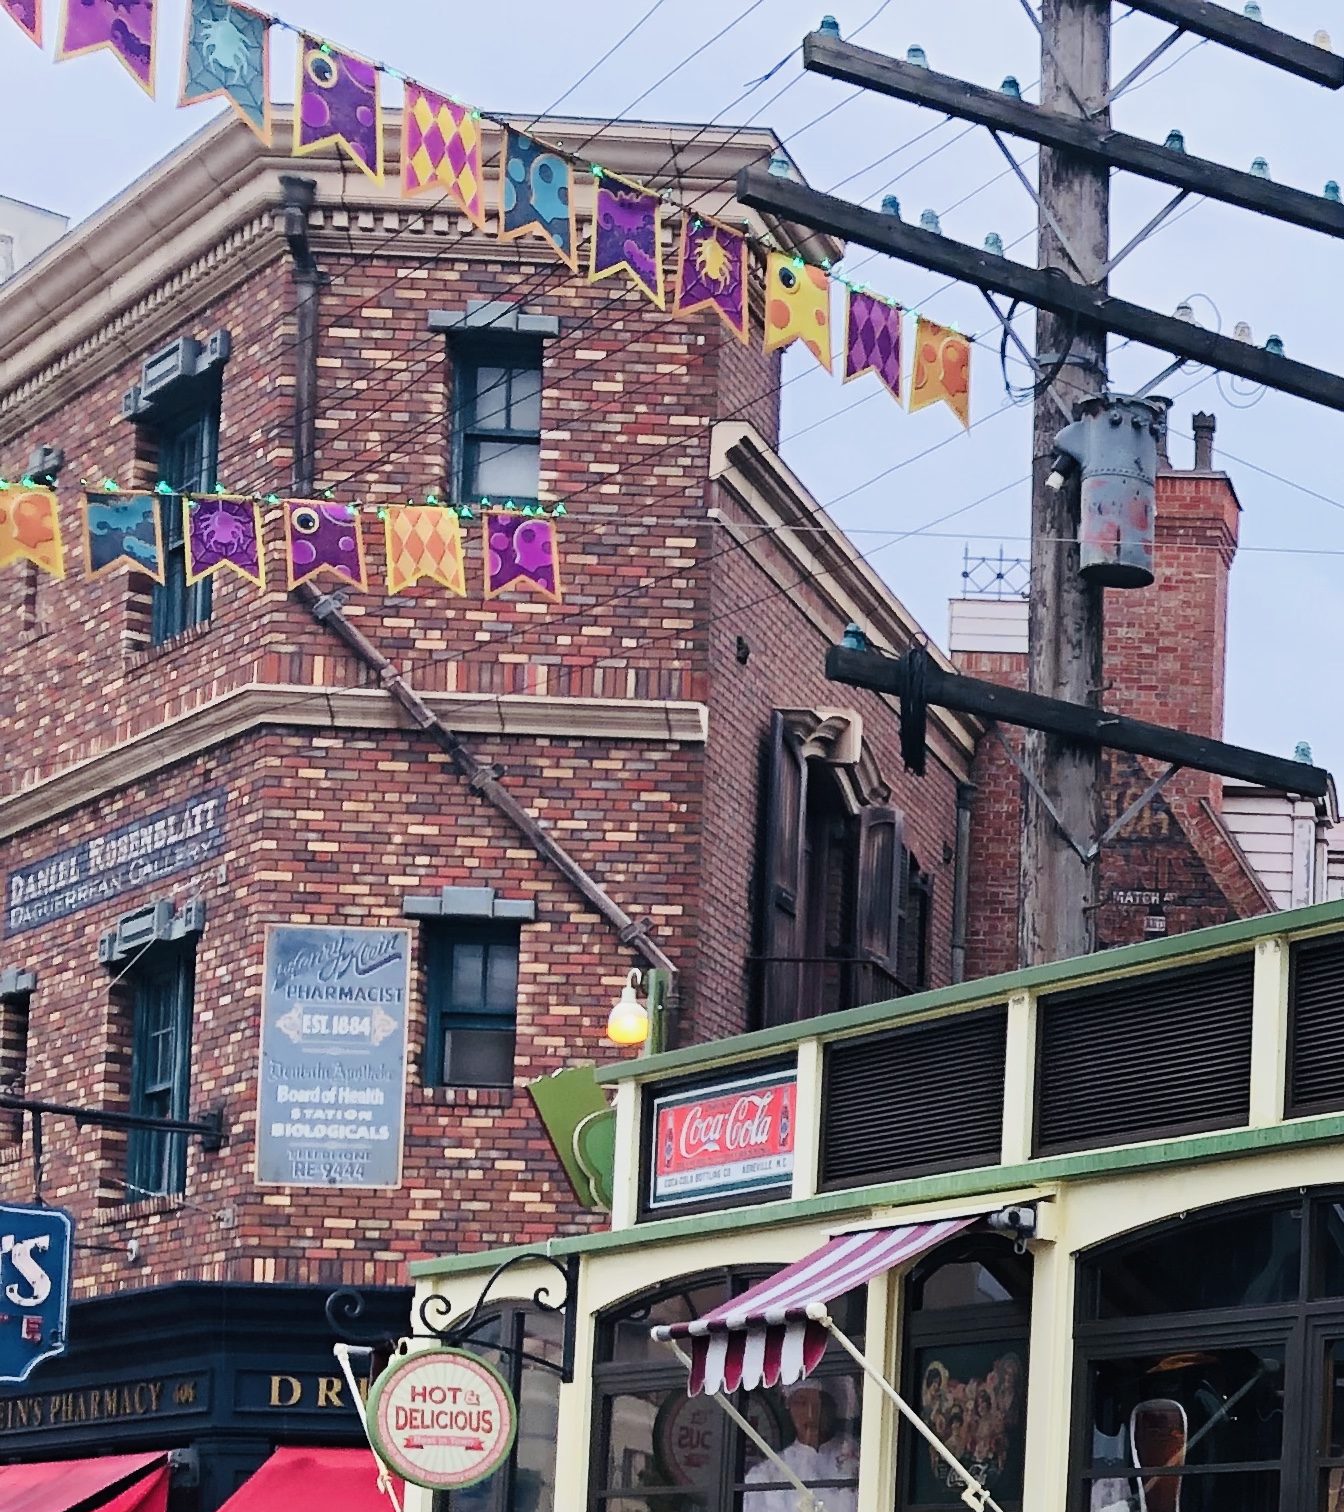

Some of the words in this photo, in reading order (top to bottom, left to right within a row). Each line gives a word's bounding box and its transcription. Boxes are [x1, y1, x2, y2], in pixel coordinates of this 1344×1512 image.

[129, 839, 214, 885] GALLERY
[10, 856, 80, 907] DANIEL
[285, 985, 404, 1004] PHARMACIST
[332, 1015, 371, 1036] 1884
[277, 1084, 321, 1104] Board
[321, 1086, 337, 1104] of
[338, 1086, 385, 1105] Health
[291, 1108, 373, 1121] STATION
[679, 1091, 774, 1158] Coca-Cola
[271, 1122, 390, 1140] BIOLOGICALS
[50, 1383, 163, 1423] PHARMACY
[269, 1375, 368, 1408] DR
[410, 1385, 462, 1405] HOT
[463, 1390, 480, 1406] &
[395, 1406, 493, 1434] DELICIOUS
